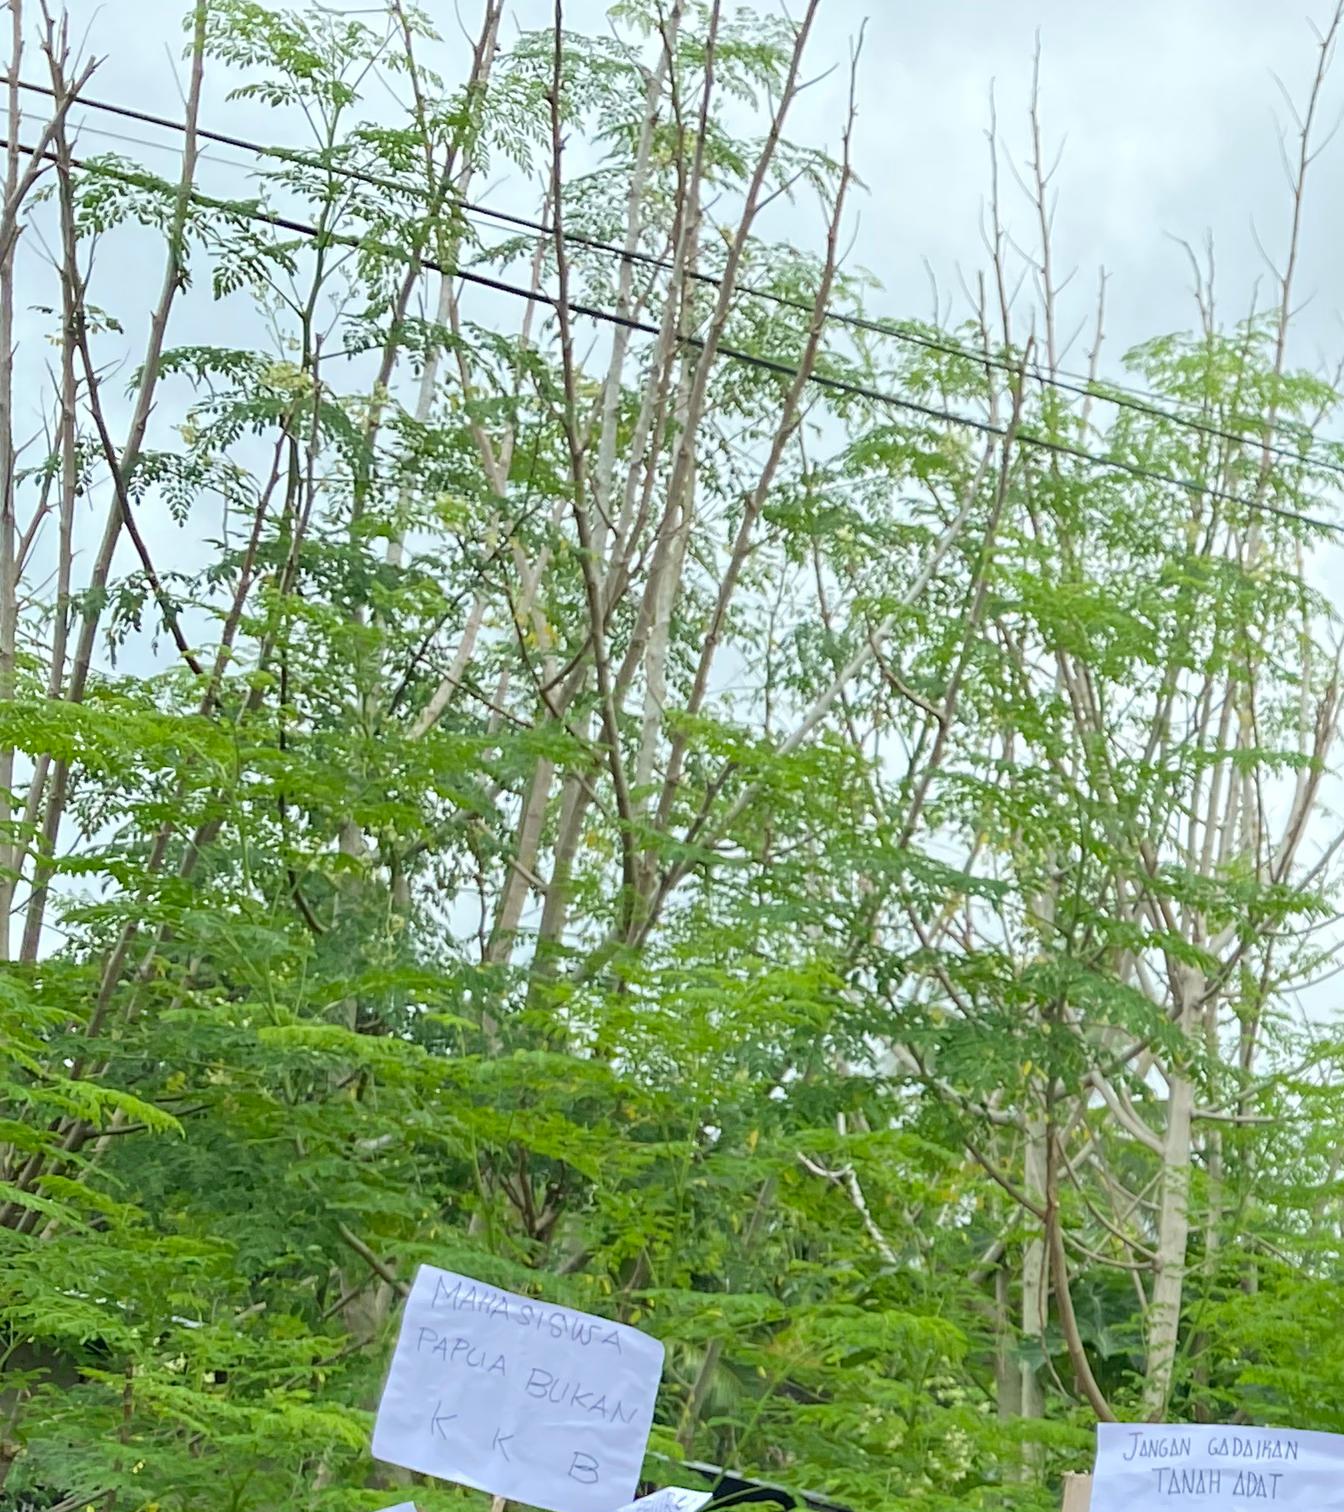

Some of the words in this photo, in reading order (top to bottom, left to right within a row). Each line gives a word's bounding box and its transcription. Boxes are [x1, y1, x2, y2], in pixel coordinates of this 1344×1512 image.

[431, 1275, 624, 1355] MAHASISWA
[415, 1326, 507, 1377] PAPUA
[524, 1366, 638, 1425] BUKAN
[1123, 1432, 1192, 1461] JANGAN
[1207, 1437, 1299, 1460] GADAIKAN
[1152, 1467, 1221, 1496] TANAH
[1232, 1472, 1284, 1499] ADAT
